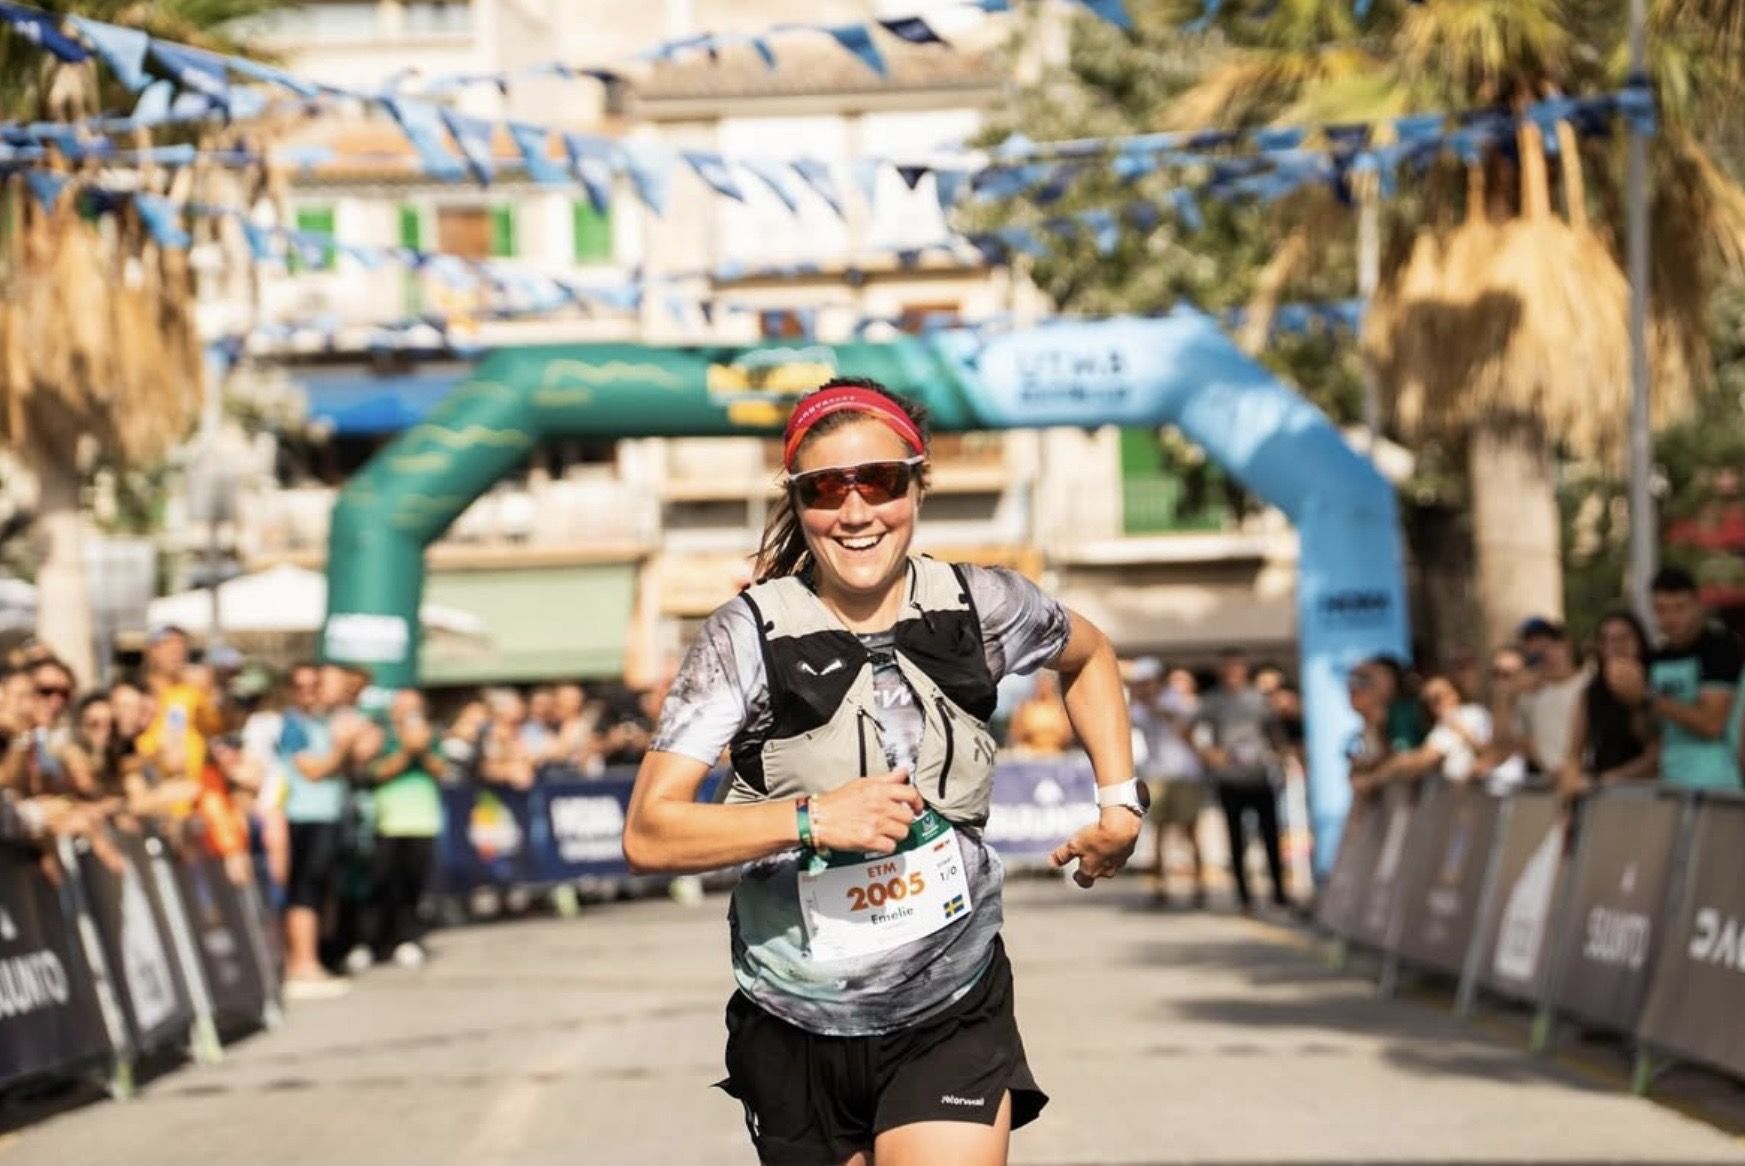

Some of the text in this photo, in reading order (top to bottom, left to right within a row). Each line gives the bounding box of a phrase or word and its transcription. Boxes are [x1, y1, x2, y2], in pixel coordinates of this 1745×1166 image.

[867, 862, 897, 878] ETM
[846, 872, 926, 912] 2005
[871, 906, 914, 925] Emelie
[0, 949, 69, 1018] UUNTO
